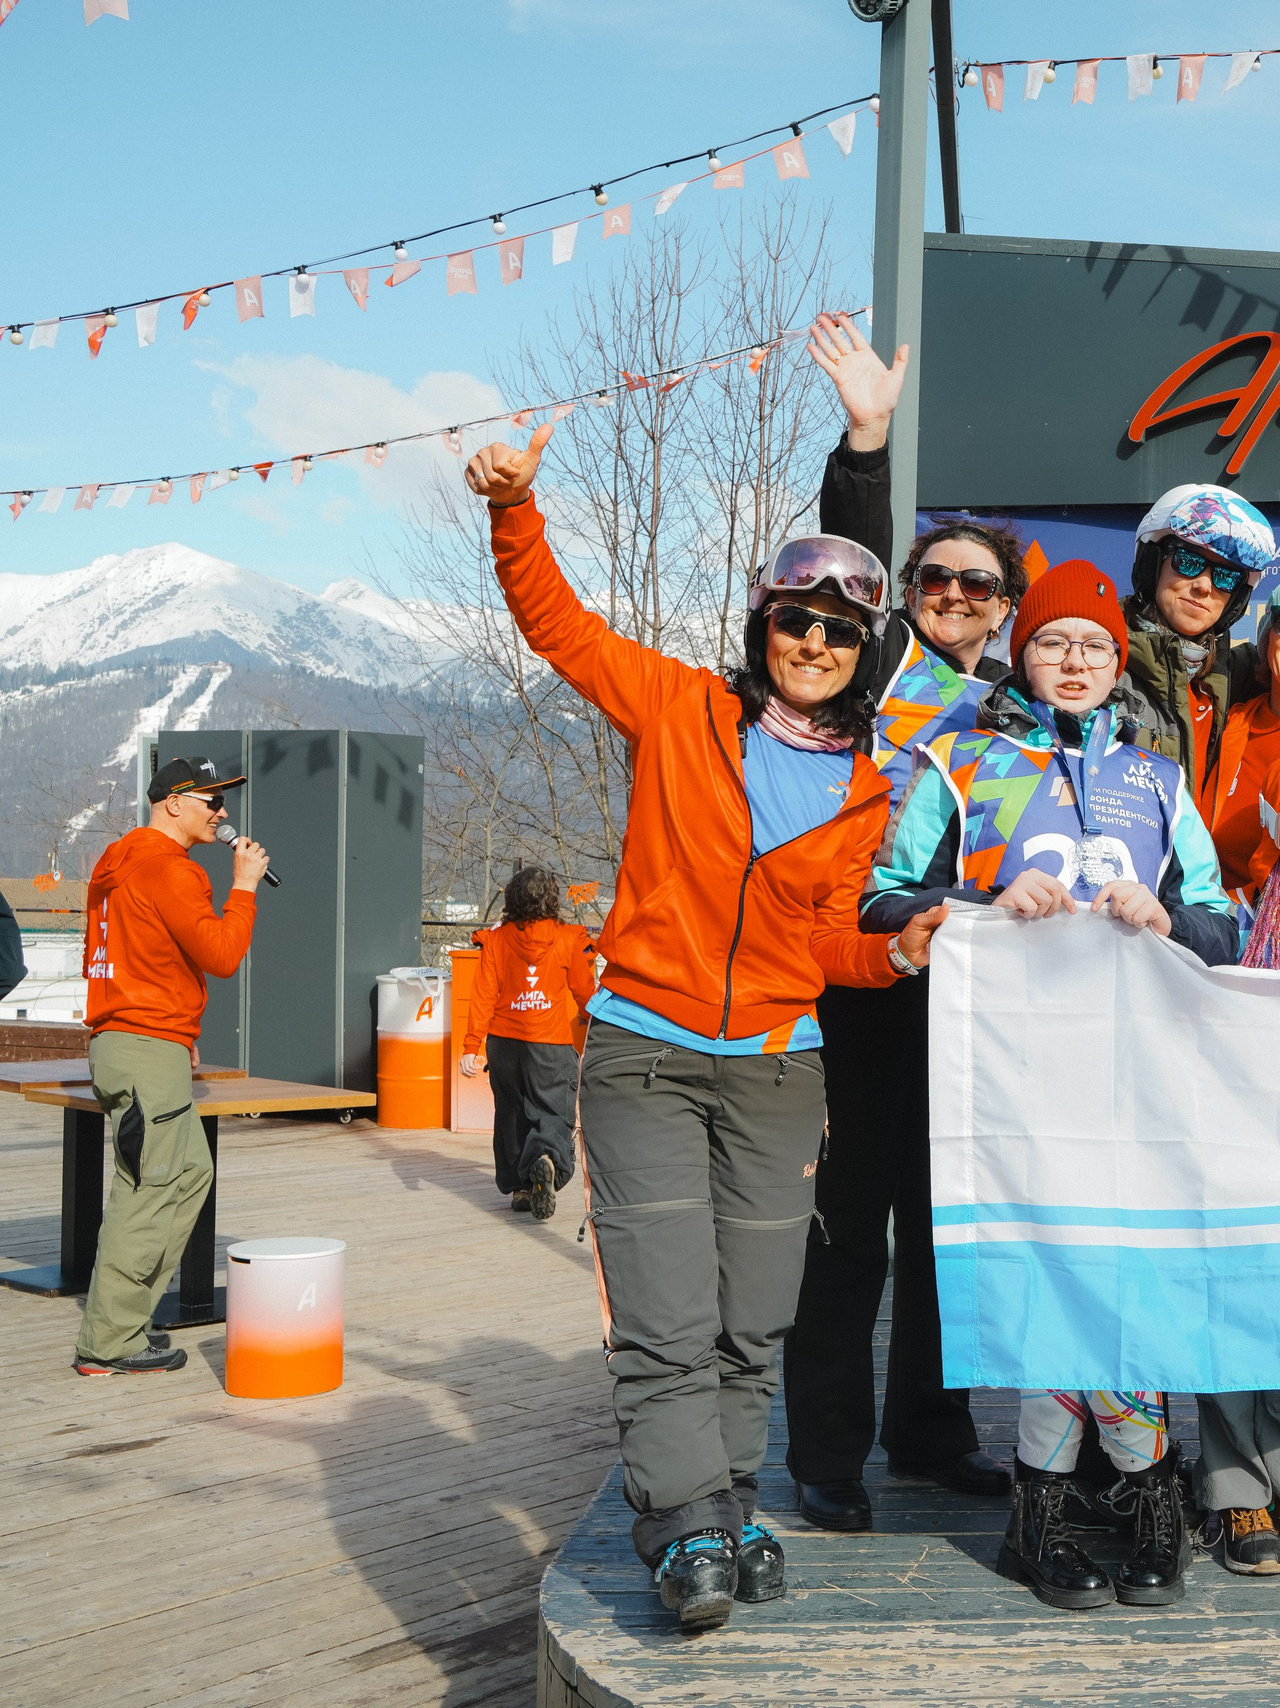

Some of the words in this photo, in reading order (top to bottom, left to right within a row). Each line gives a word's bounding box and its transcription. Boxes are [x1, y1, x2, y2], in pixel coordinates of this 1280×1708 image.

[1102, 789, 1145, 803] ПОДДЕРЖКЕ
[1089, 804, 1159, 829] ПРЕЗИДЕНТСКИХ
[1093, 813, 1132, 828] РАНТОВ
[517, 990, 546, 1001] ЛИГА
[416, 996, 432, 1022] A
[510, 1000, 552, 1011] МЕЧТЫ
[297, 1281, 316, 1311] A
